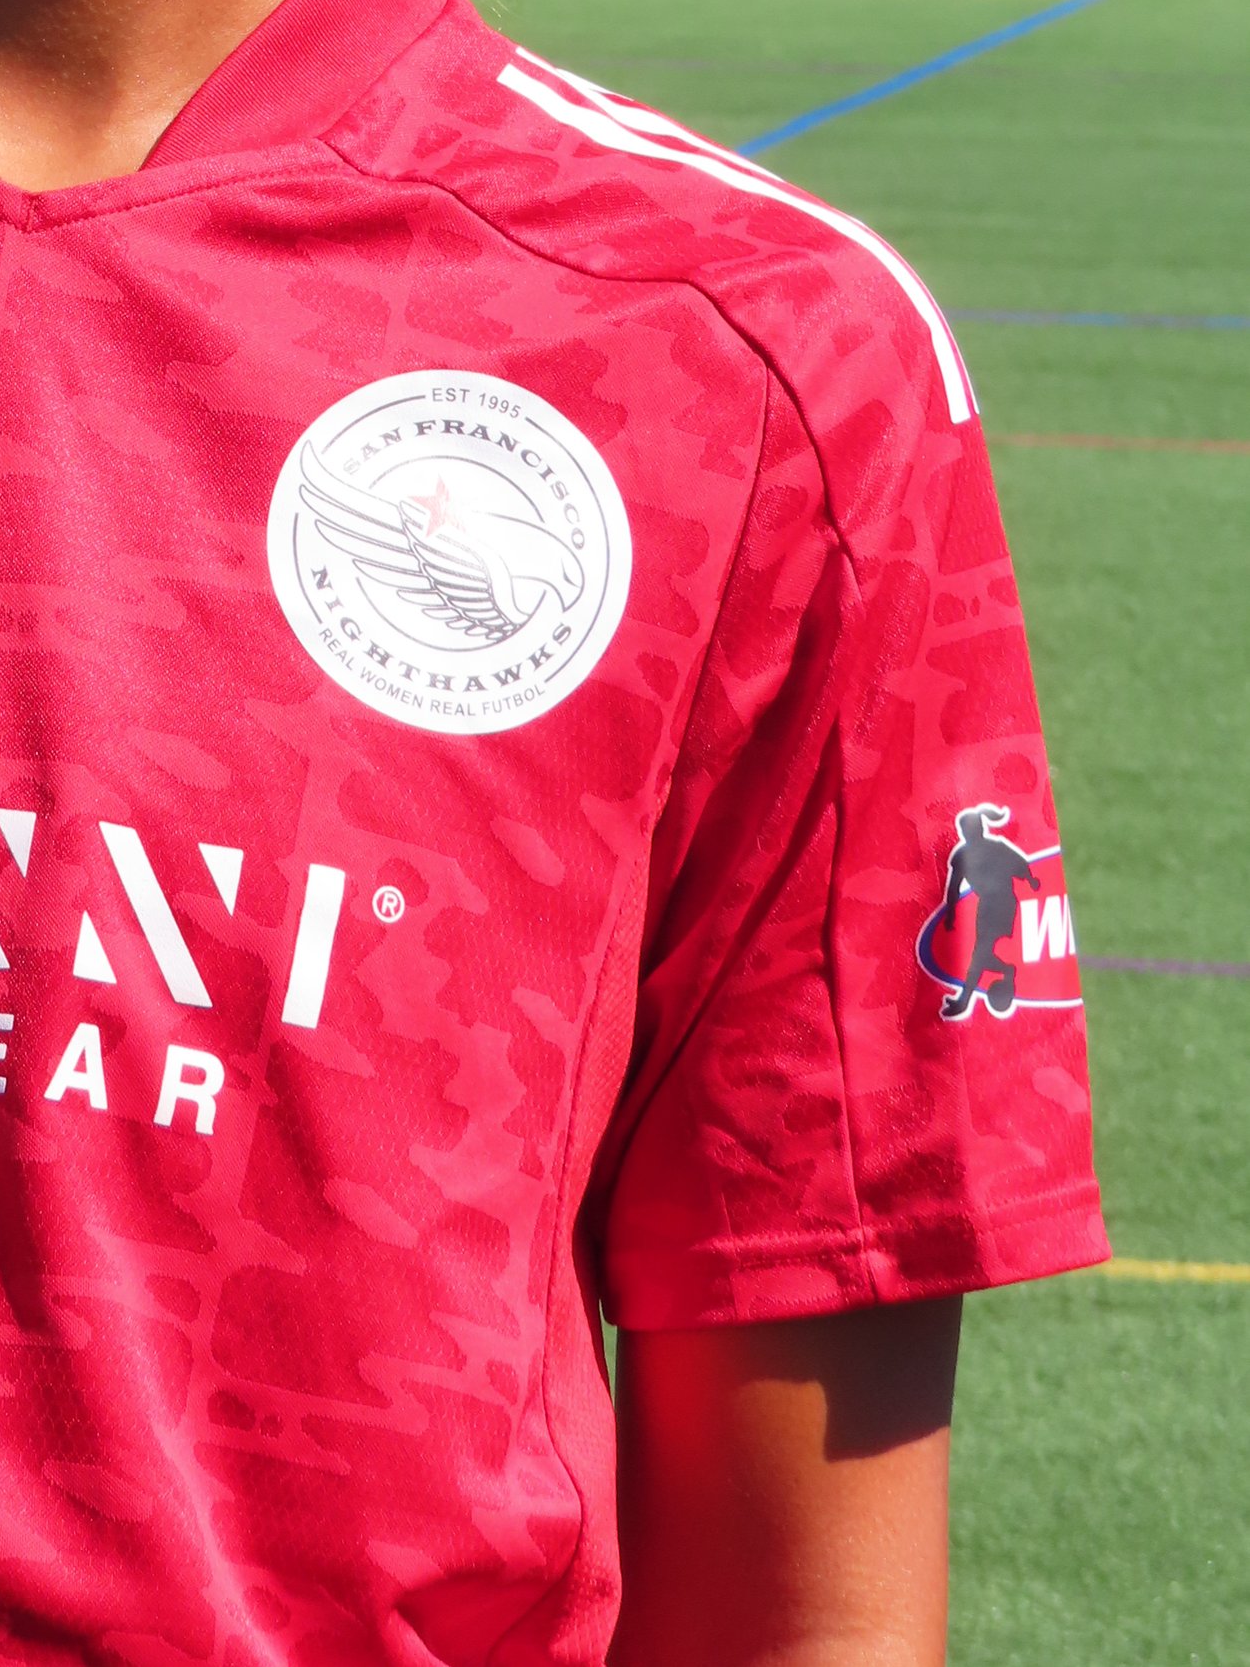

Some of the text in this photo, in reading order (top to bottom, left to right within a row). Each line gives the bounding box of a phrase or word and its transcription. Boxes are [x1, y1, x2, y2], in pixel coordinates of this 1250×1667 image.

[432, 388, 523, 419] EST 1995
[343, 419, 586, 550] SAN FRANCISCO
[311, 565, 572, 692] NIGHTHAWKS
[319, 628, 545, 716] REAL WOMEN REAL FUTBOL
